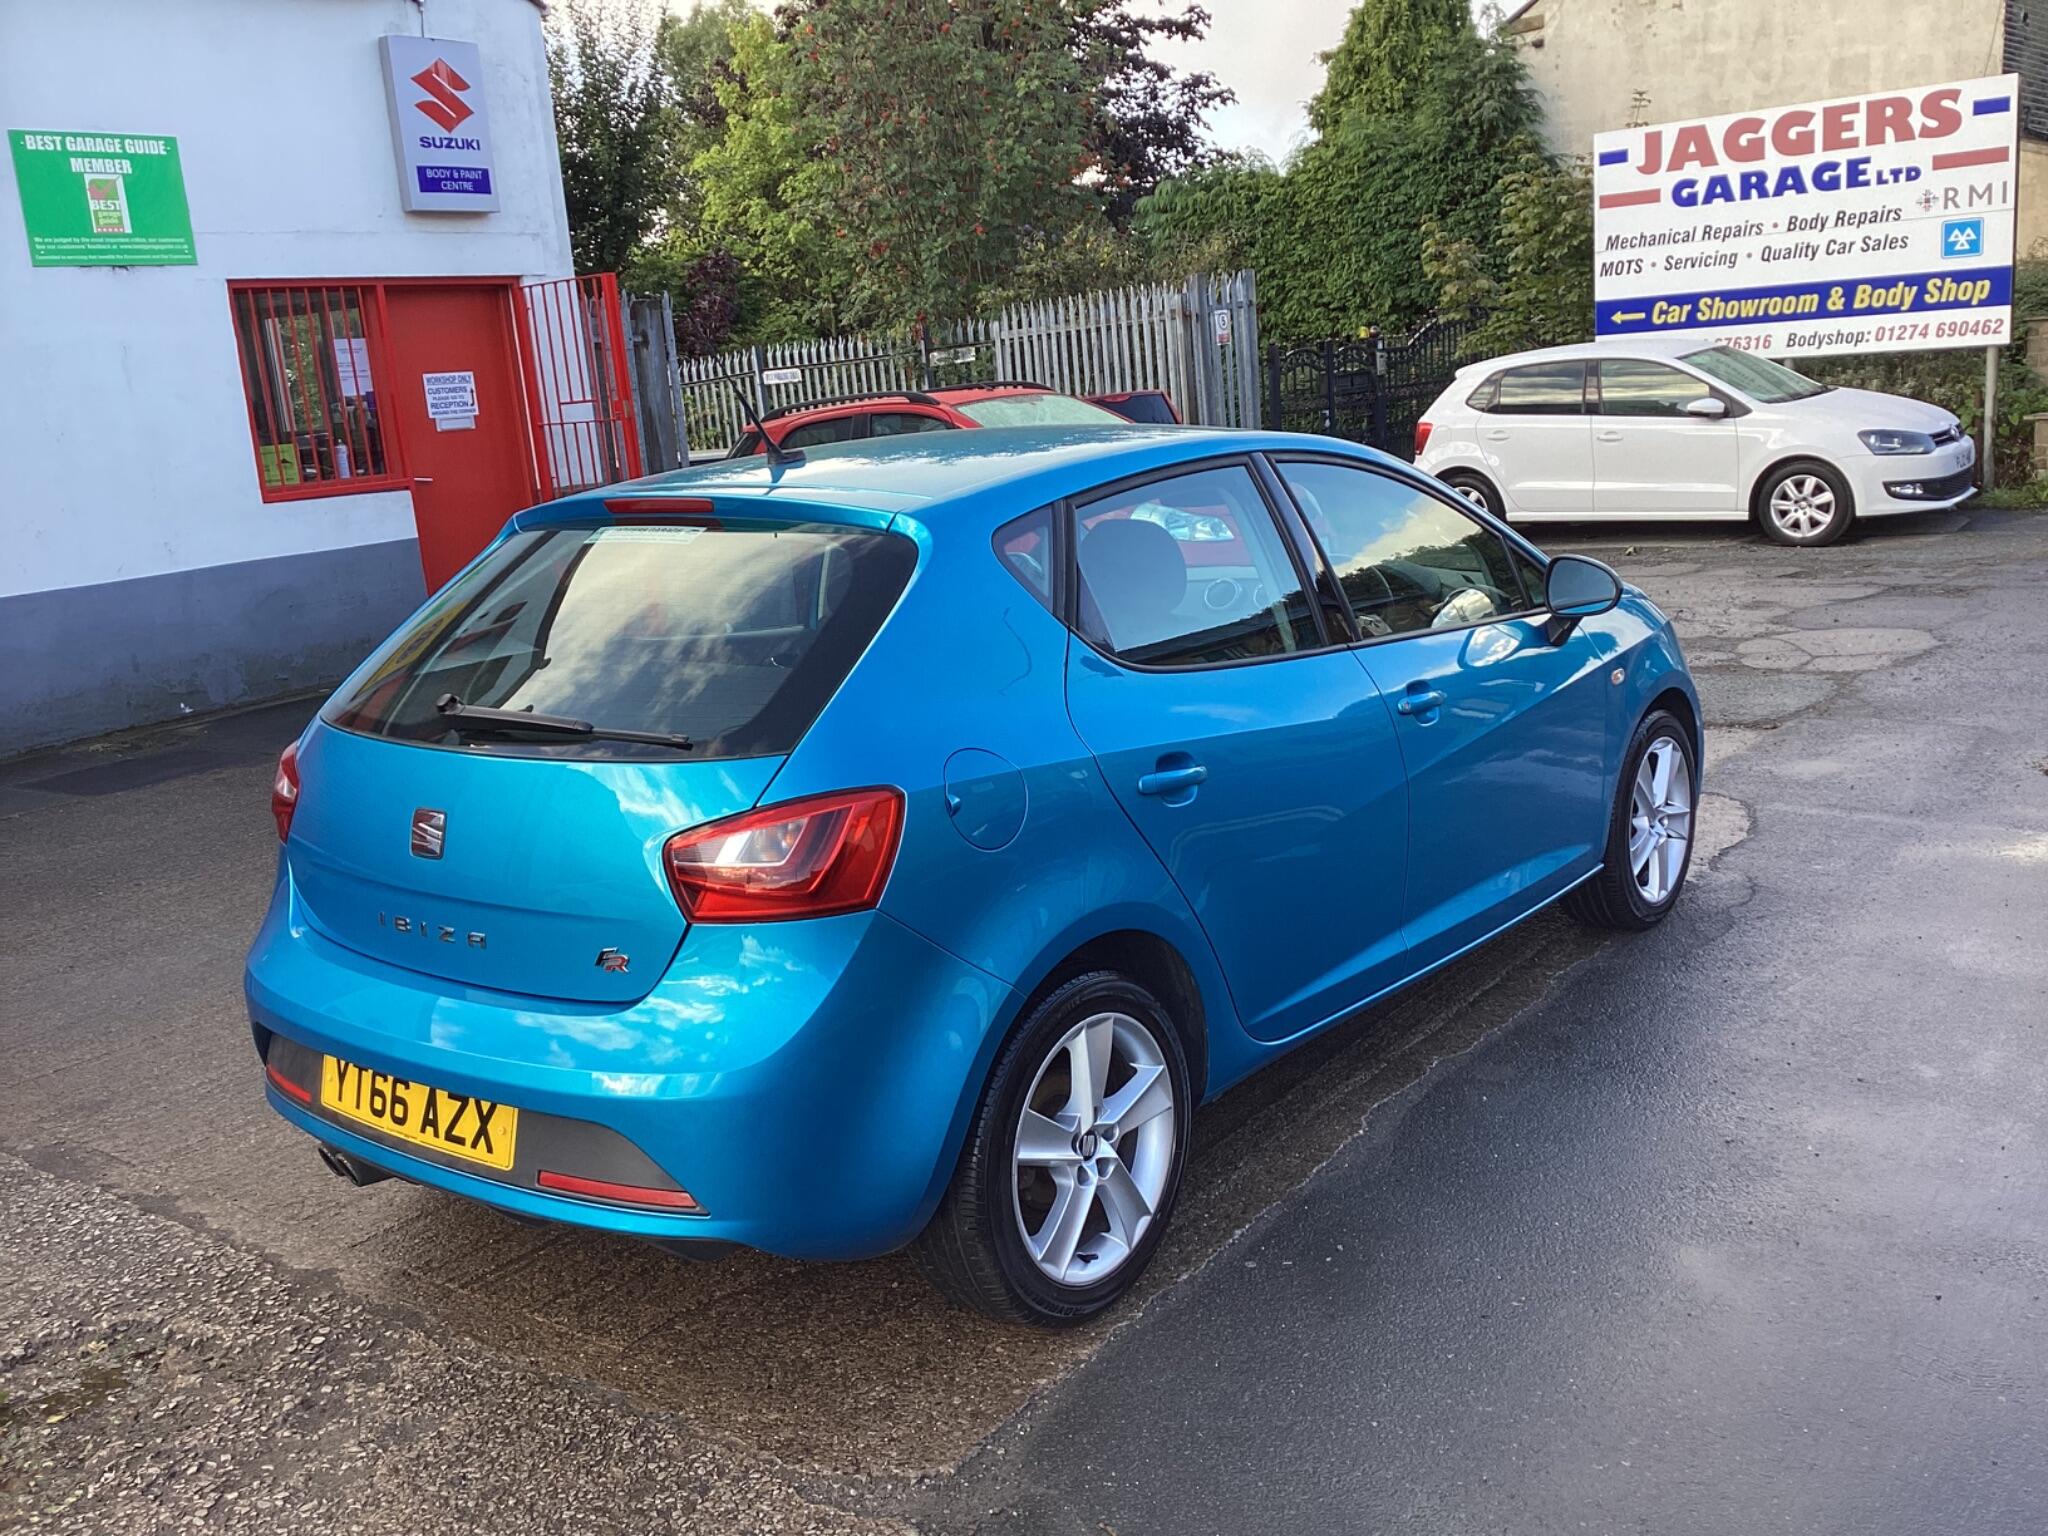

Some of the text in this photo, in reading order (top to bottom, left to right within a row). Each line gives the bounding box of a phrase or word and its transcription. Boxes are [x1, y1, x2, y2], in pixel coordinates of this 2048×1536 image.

[24, 134, 168, 155] BEST GARAGE GUIDE
[419, 136, 481, 151] SUZUKI
[1636, 88, 1963, 176] JAGGERS
[69, 157, 133, 174] MEMBER
[426, 167, 483, 179] BODY & PAINT
[441, 180, 474, 191] CENTRE
[1671, 155, 1922, 208] GARAGE LTD
[1943, 180, 2008, 211] RMI
[91, 200, 120, 210] BEST
[1605, 205, 1903, 251] Mechanical Repairs Body Repairs
[1600, 232, 1910, 278] MOTS Servicing Quality Car Sales
[1652, 276, 1991, 325] Car Showroom & Body Shop
[1786, 329, 1872, 350] Bodyshop:
[1874, 322, 1931, 342] 01274
[1935, 317, 2005, 339] 690462
[427, 386, 468, 395] CUSTOMERS
[430, 401, 469, 410] RECEPTION
[379, 911, 488, 949] IBIZA
[335, 1057, 499, 1155] YT66 AZX
